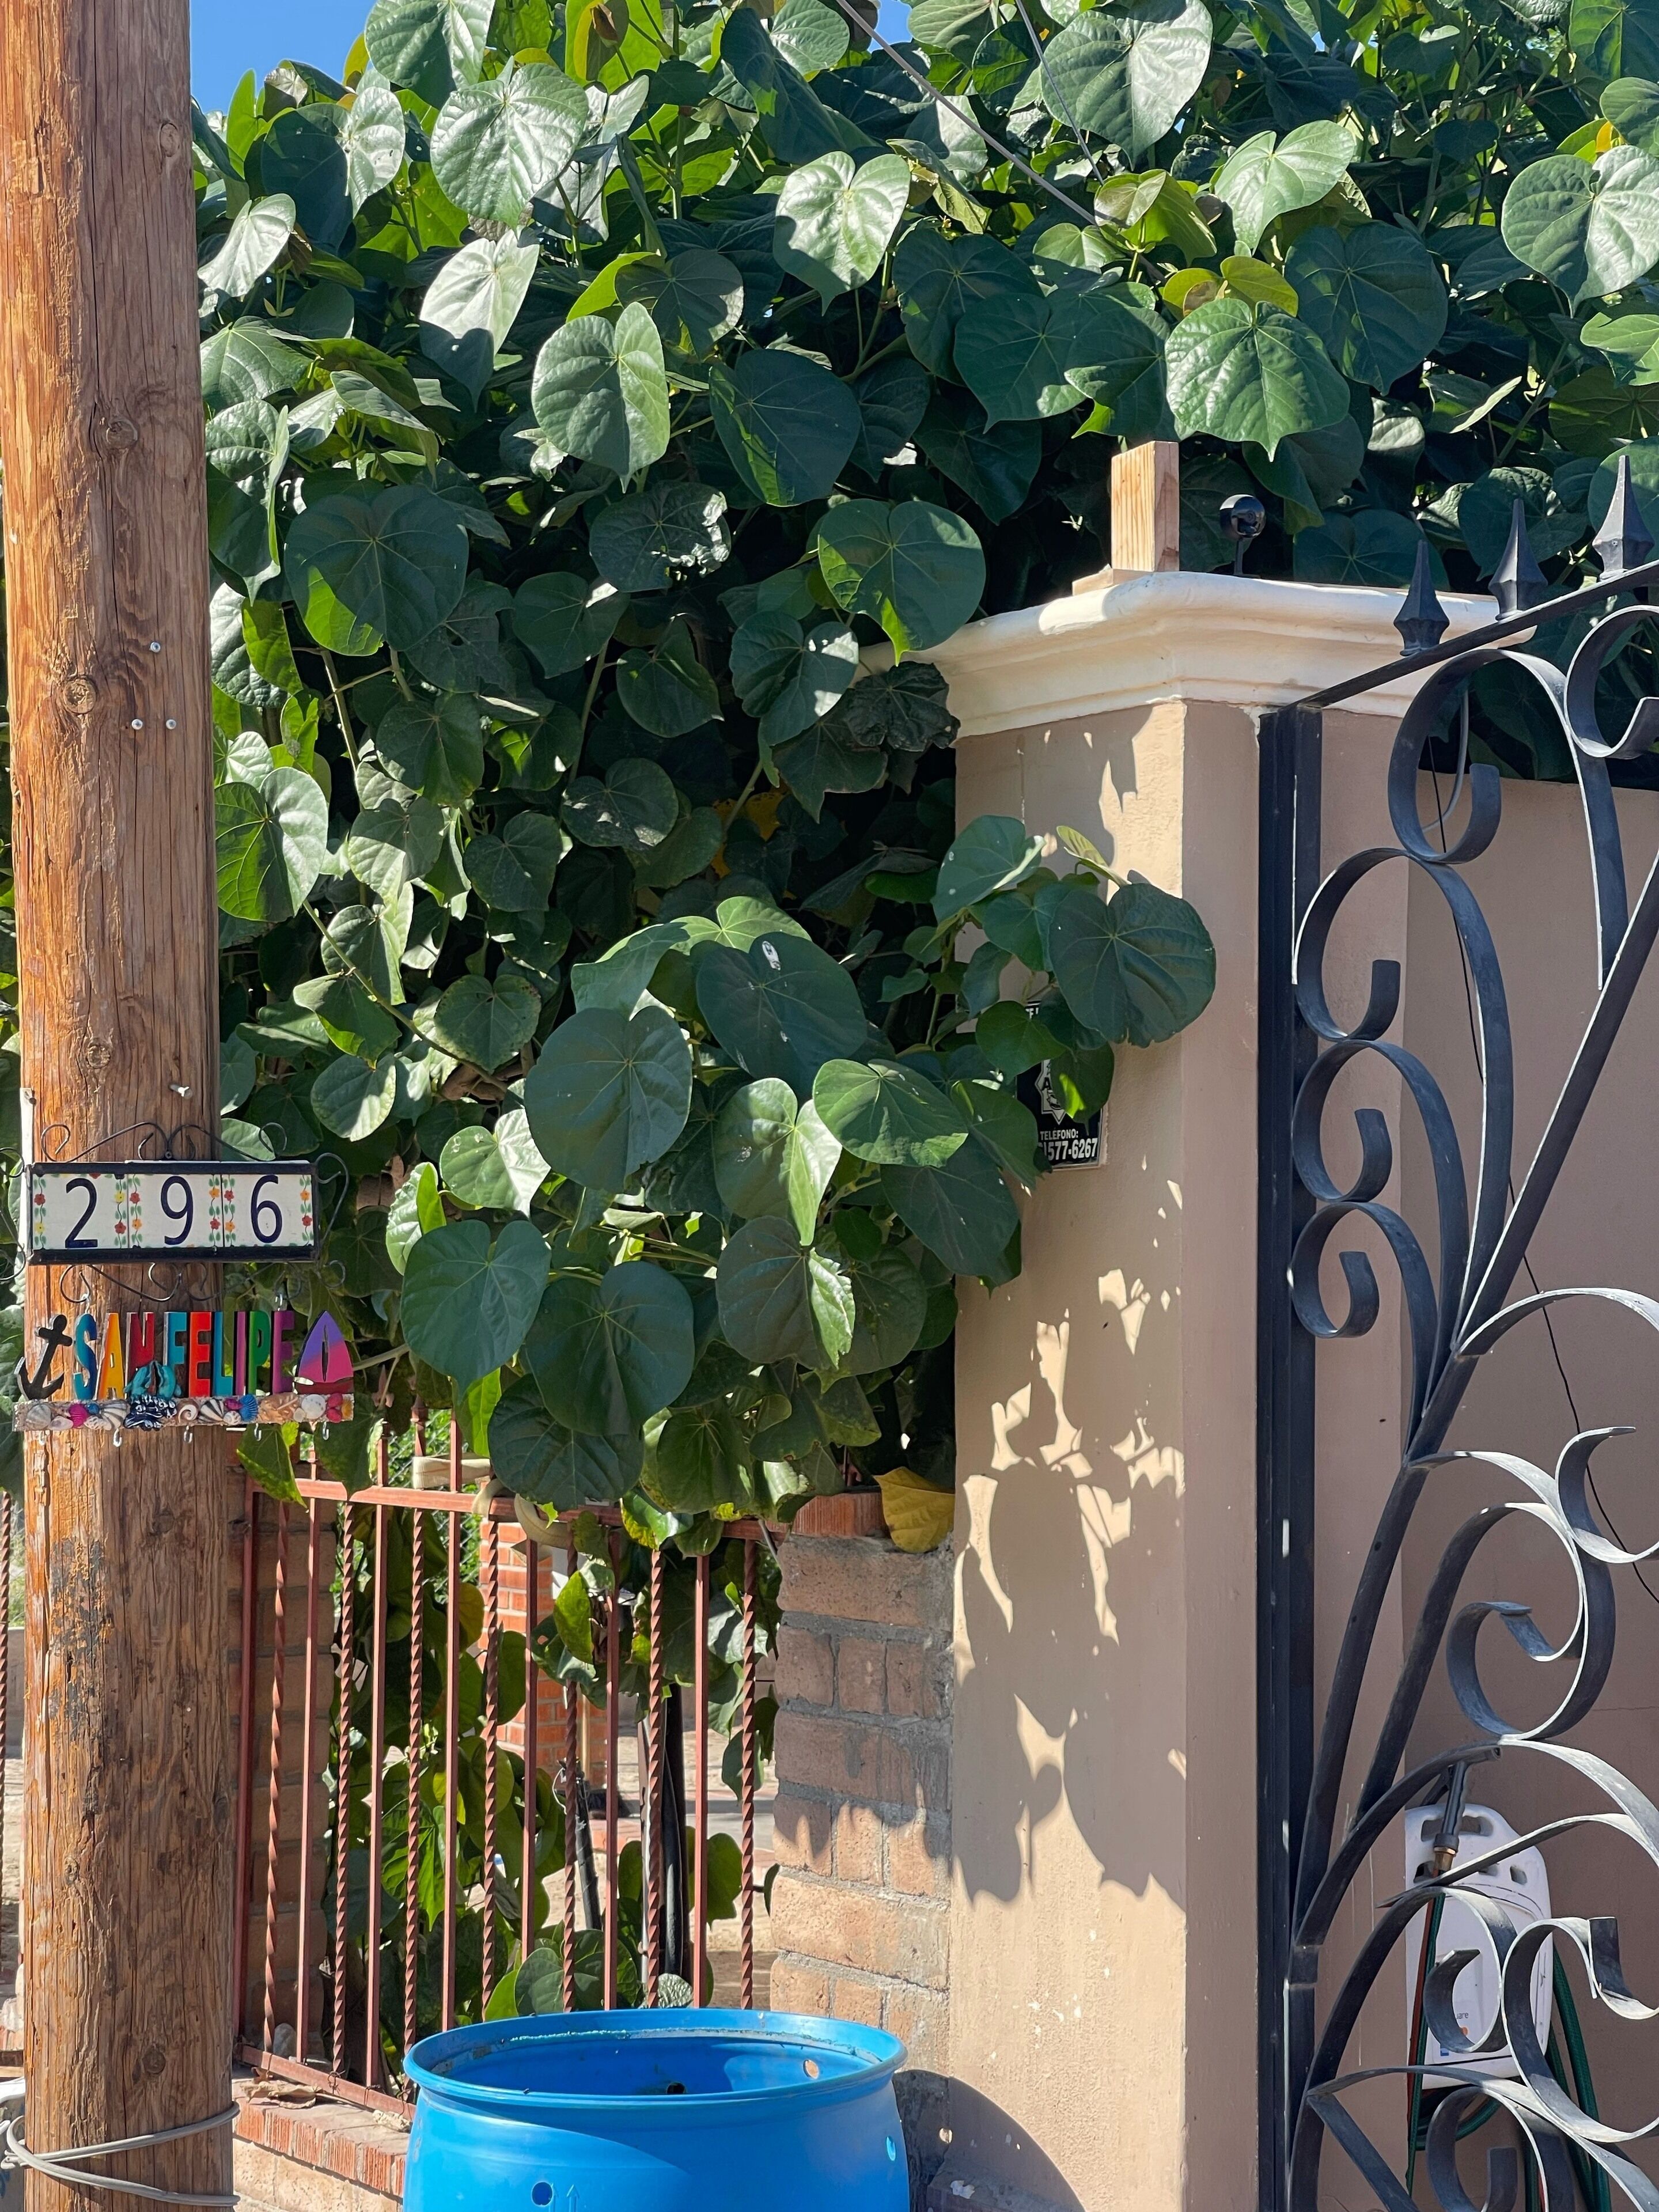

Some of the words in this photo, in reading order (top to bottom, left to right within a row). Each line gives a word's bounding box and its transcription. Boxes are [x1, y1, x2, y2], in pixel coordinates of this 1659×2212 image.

[65, 1175, 282, 1248] 296
[73, 1312, 155, 1400] SAN
[163, 1310, 294, 1399] FELIPE
